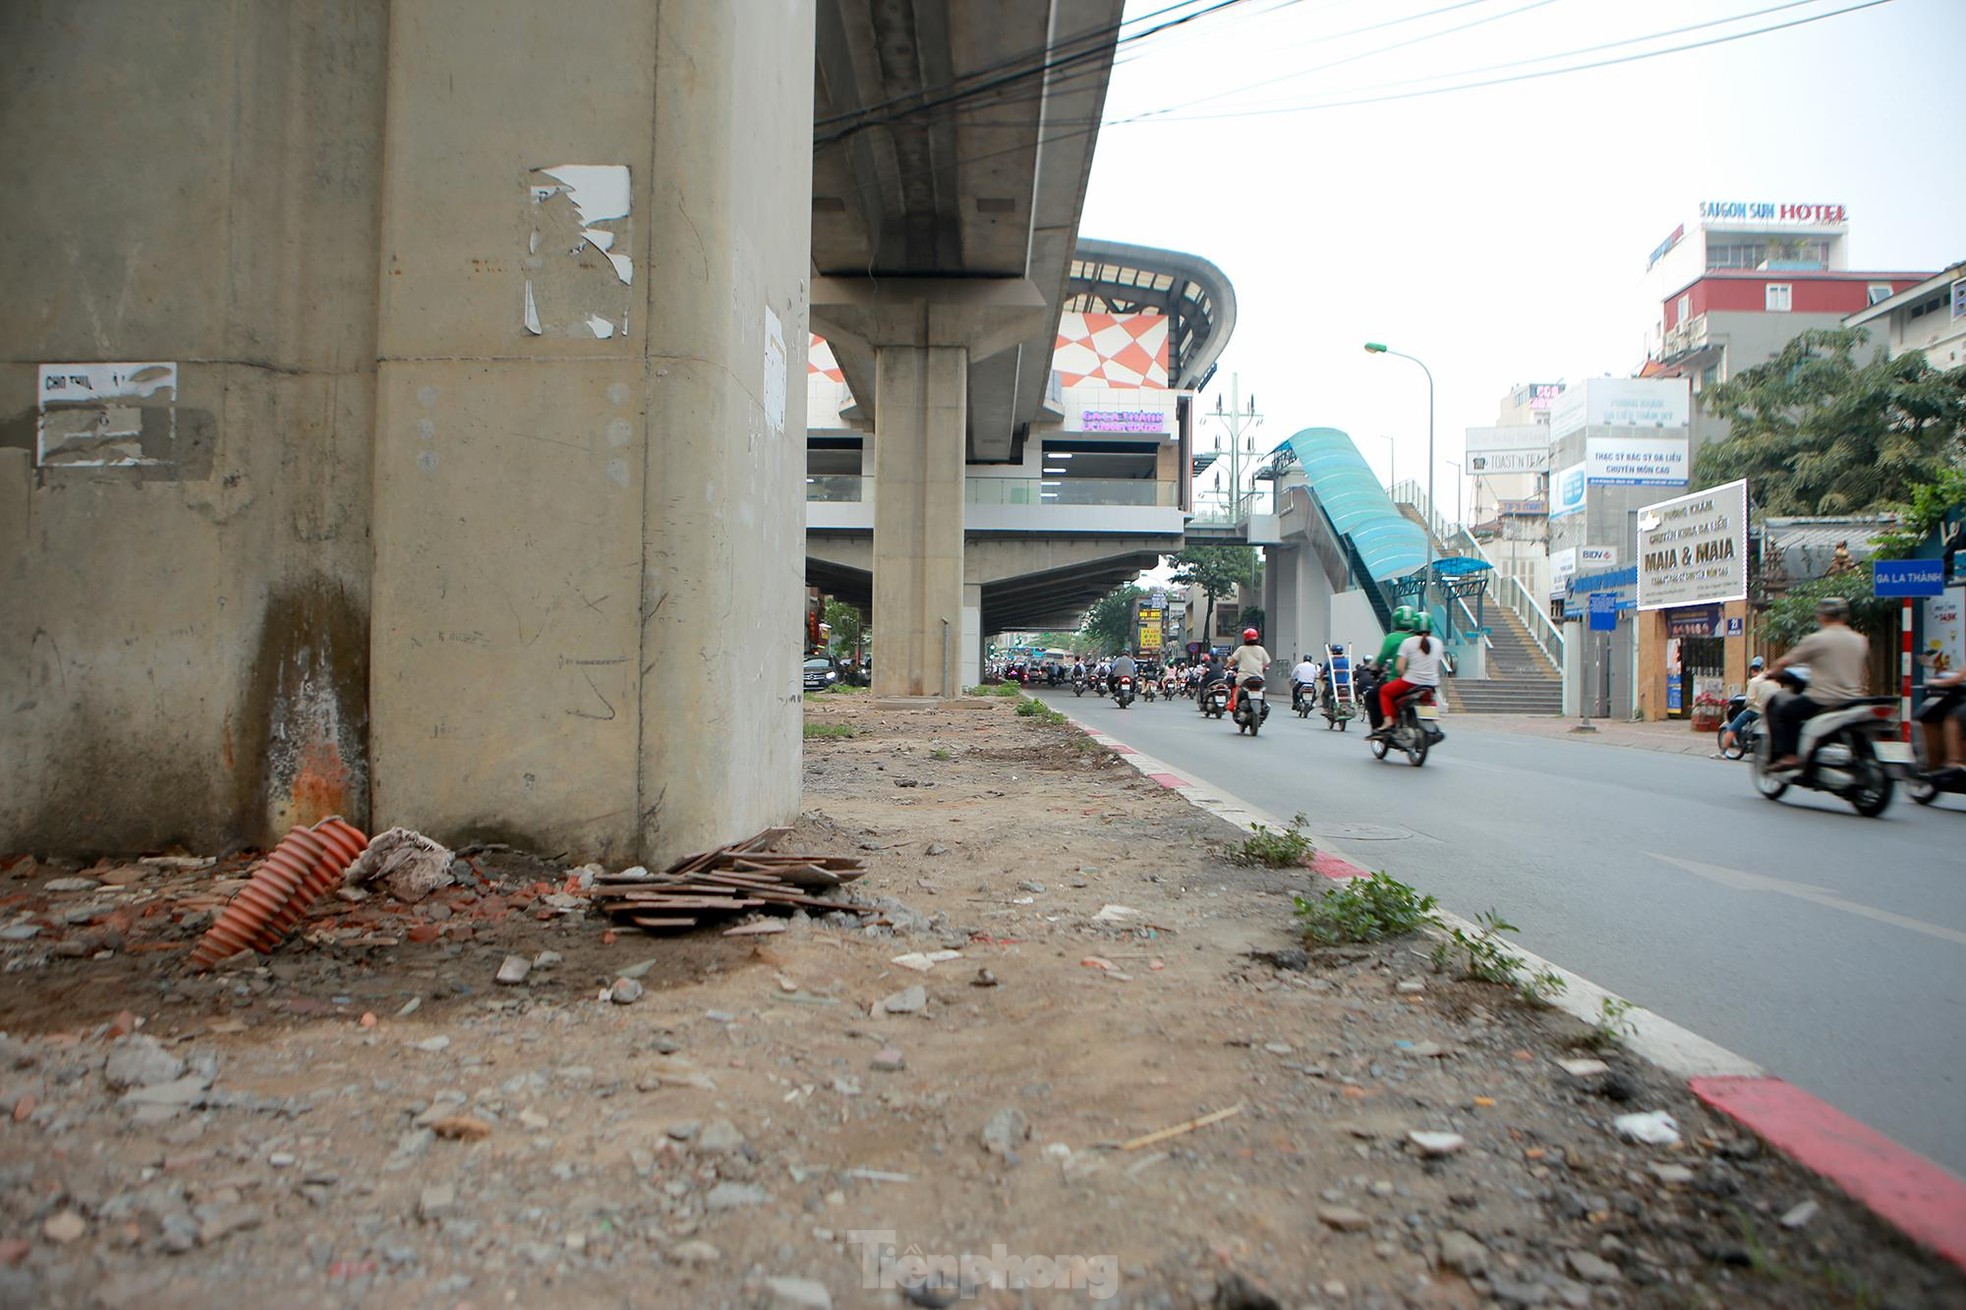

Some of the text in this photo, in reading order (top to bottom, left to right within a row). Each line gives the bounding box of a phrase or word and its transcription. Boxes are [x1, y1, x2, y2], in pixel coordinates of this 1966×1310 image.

[1700, 201, 1848, 222] SAIGON SUN HOTEL
[46, 375, 66, 390] CHO
[1491, 455, 1516, 469] TOAST
[1583, 550, 1603, 559] BIDV
[1645, 537, 1735, 573] MAIA & MAIA
[1876, 574, 1889, 584] GA
[1892, 574, 1906, 583] LA
